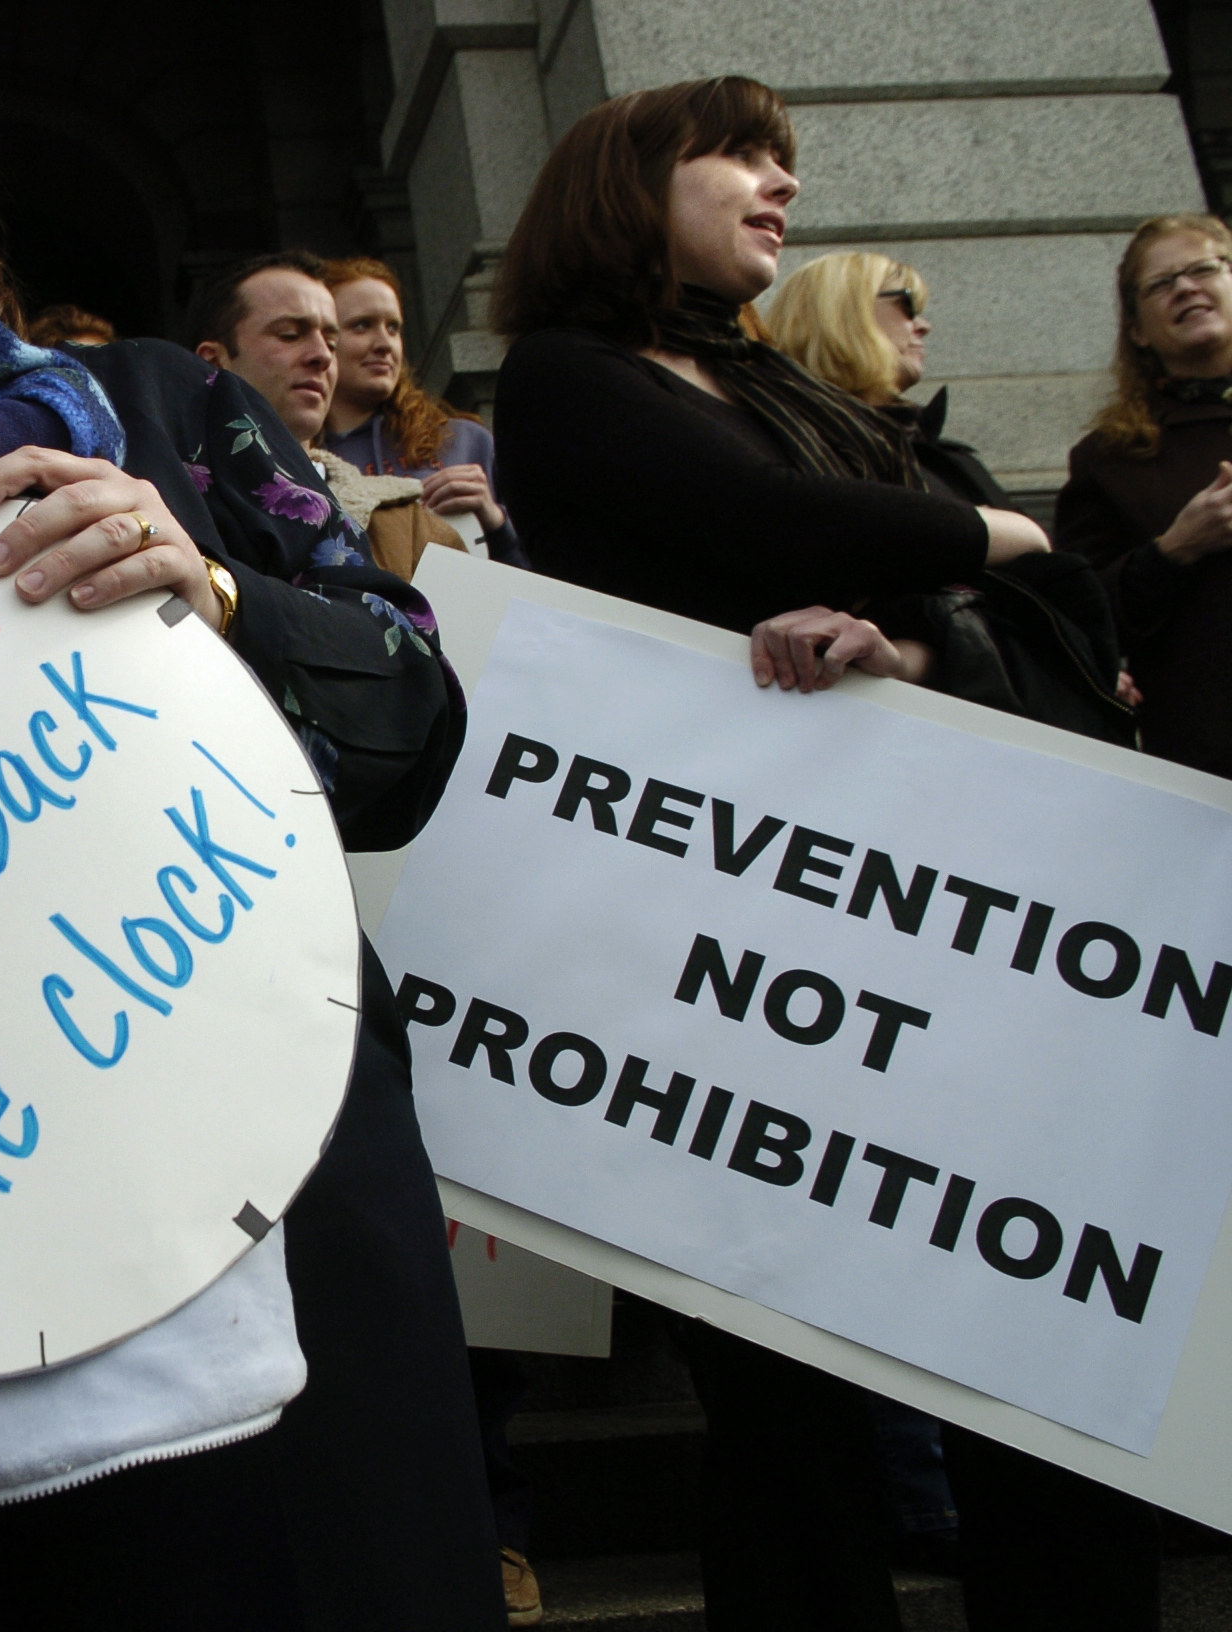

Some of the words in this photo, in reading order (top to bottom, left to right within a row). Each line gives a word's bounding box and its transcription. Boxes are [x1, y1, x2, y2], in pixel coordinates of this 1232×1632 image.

[41, 740, 298, 1070] clock!
[484, 732, 1232, 1038] PREVENTION
[673, 933, 932, 1074] NOT
[396, 972, 1163, 1325] PROHIBITION
